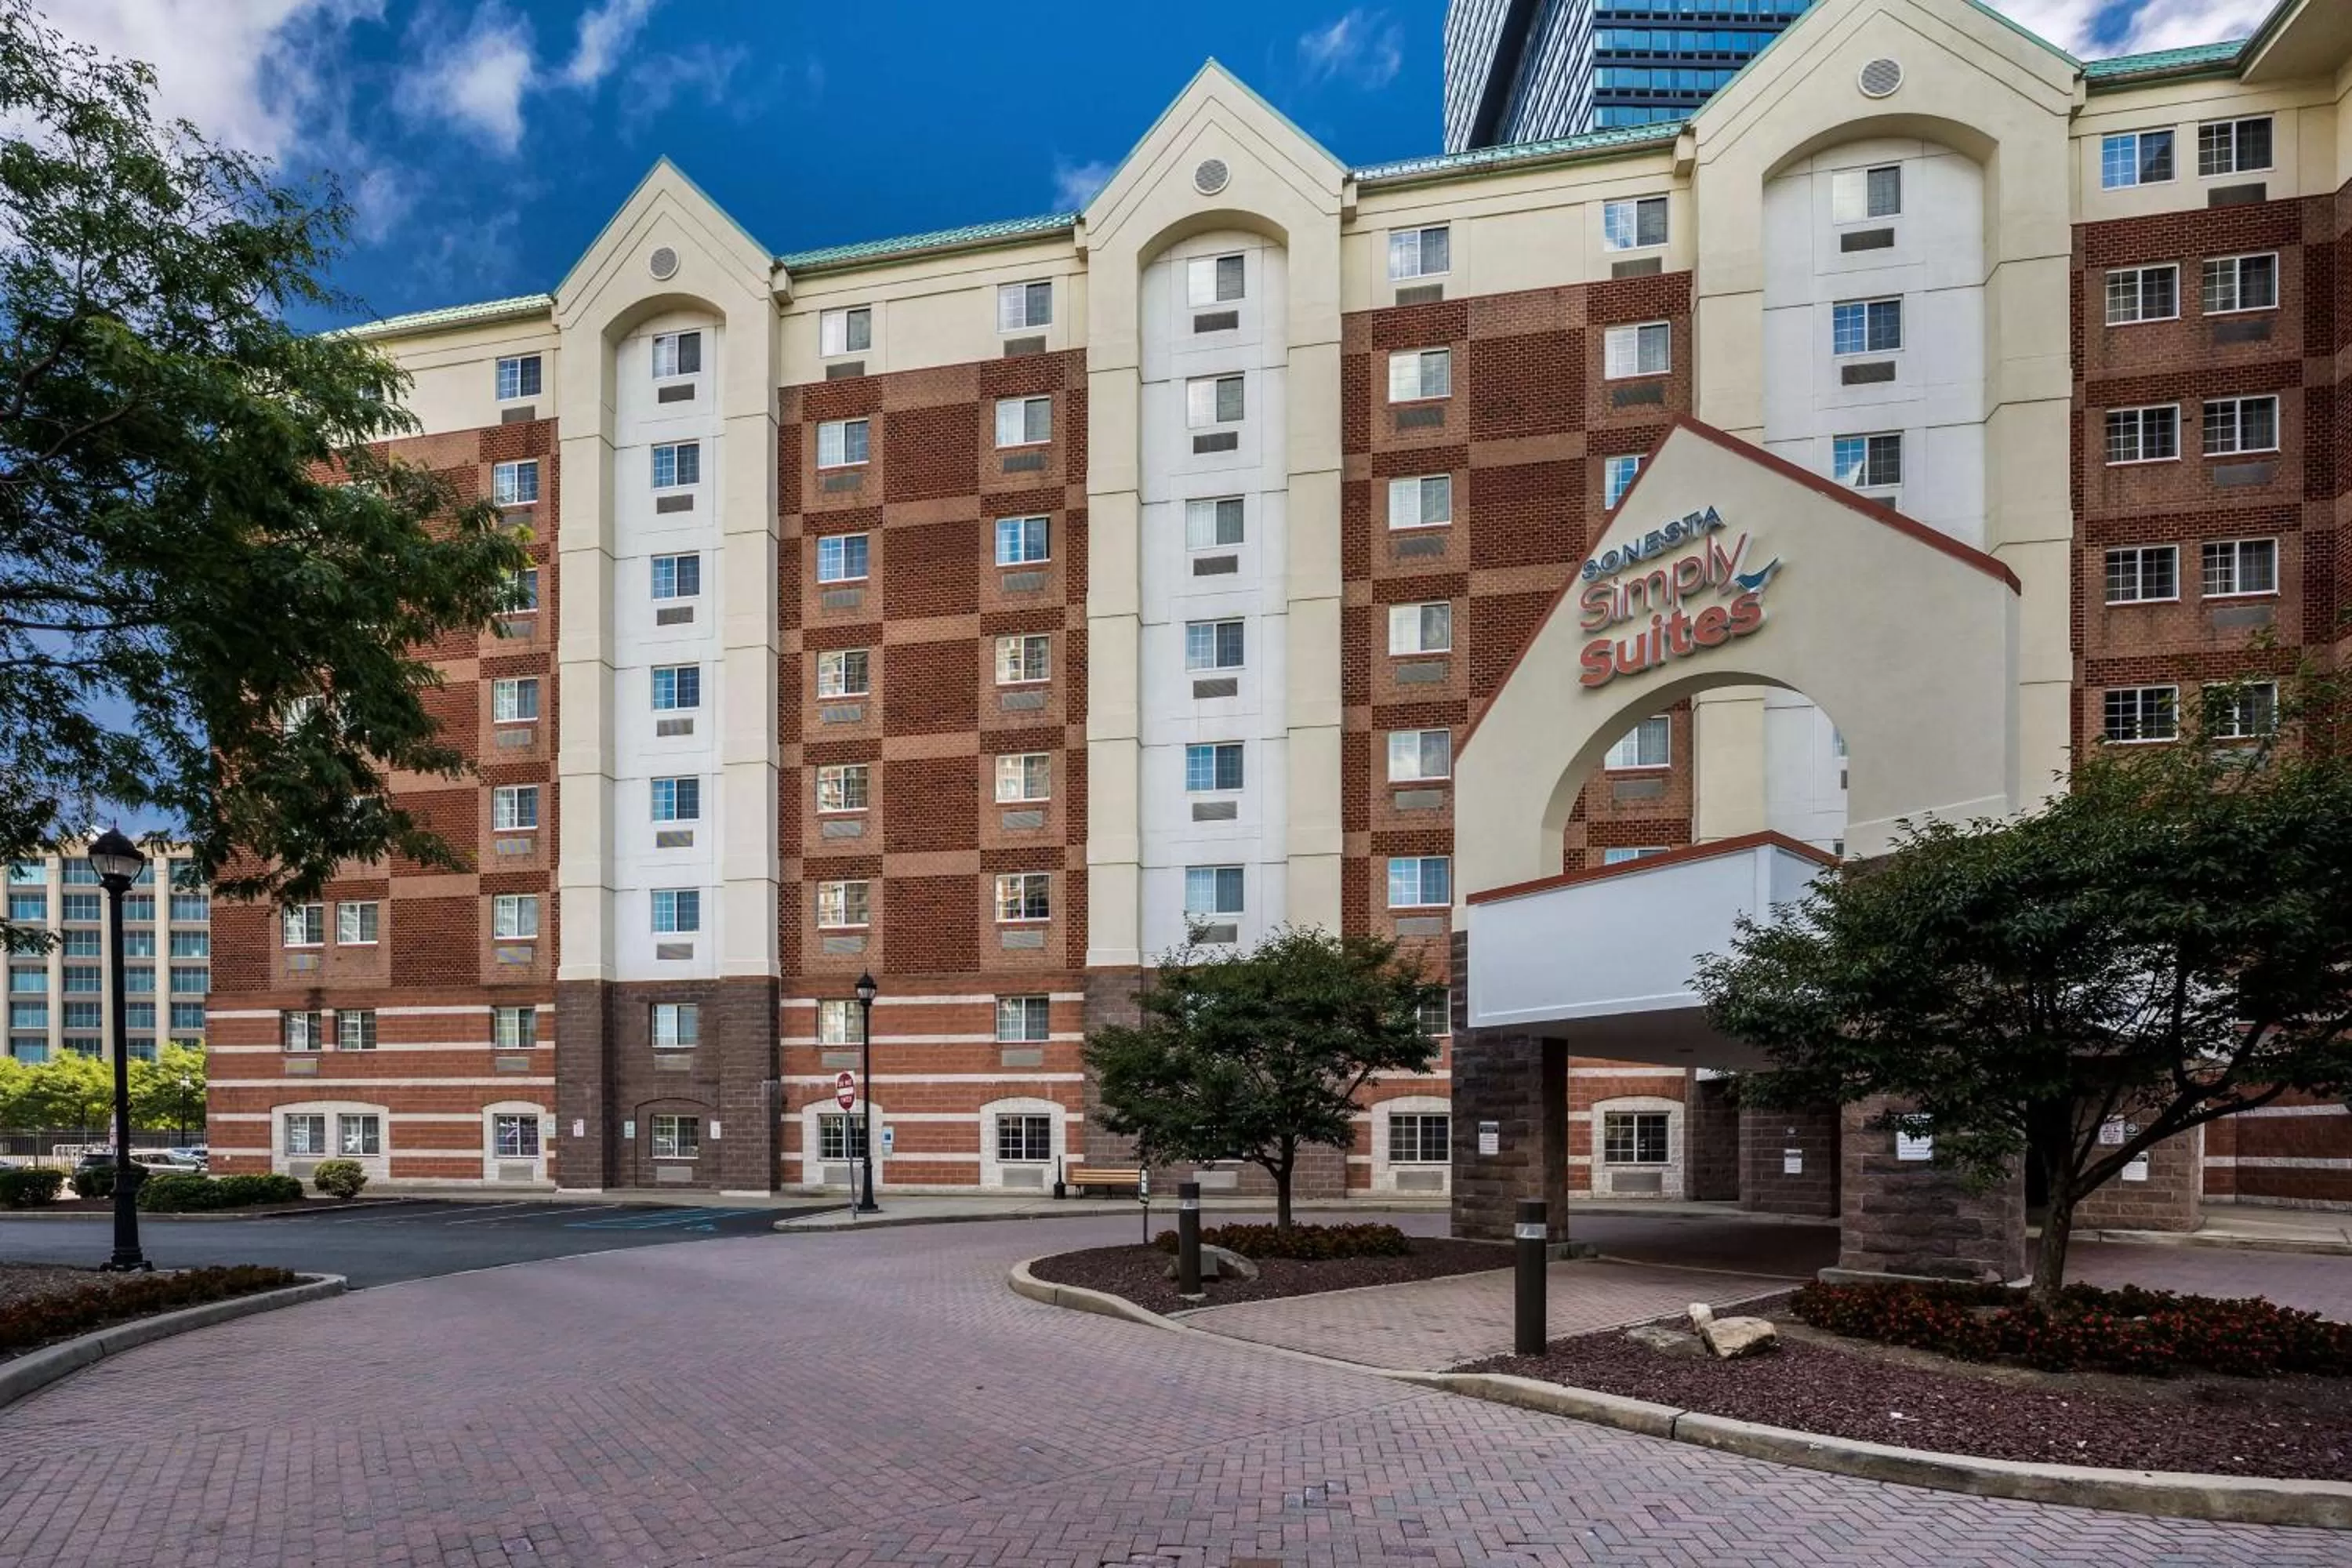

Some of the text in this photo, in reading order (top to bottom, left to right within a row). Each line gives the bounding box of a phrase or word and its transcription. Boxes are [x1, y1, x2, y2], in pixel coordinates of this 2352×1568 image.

[1580, 531, 1751, 633] Simply
[1581, 505, 1726, 582] SONESTA
[1579, 592, 1764, 688] Suites
